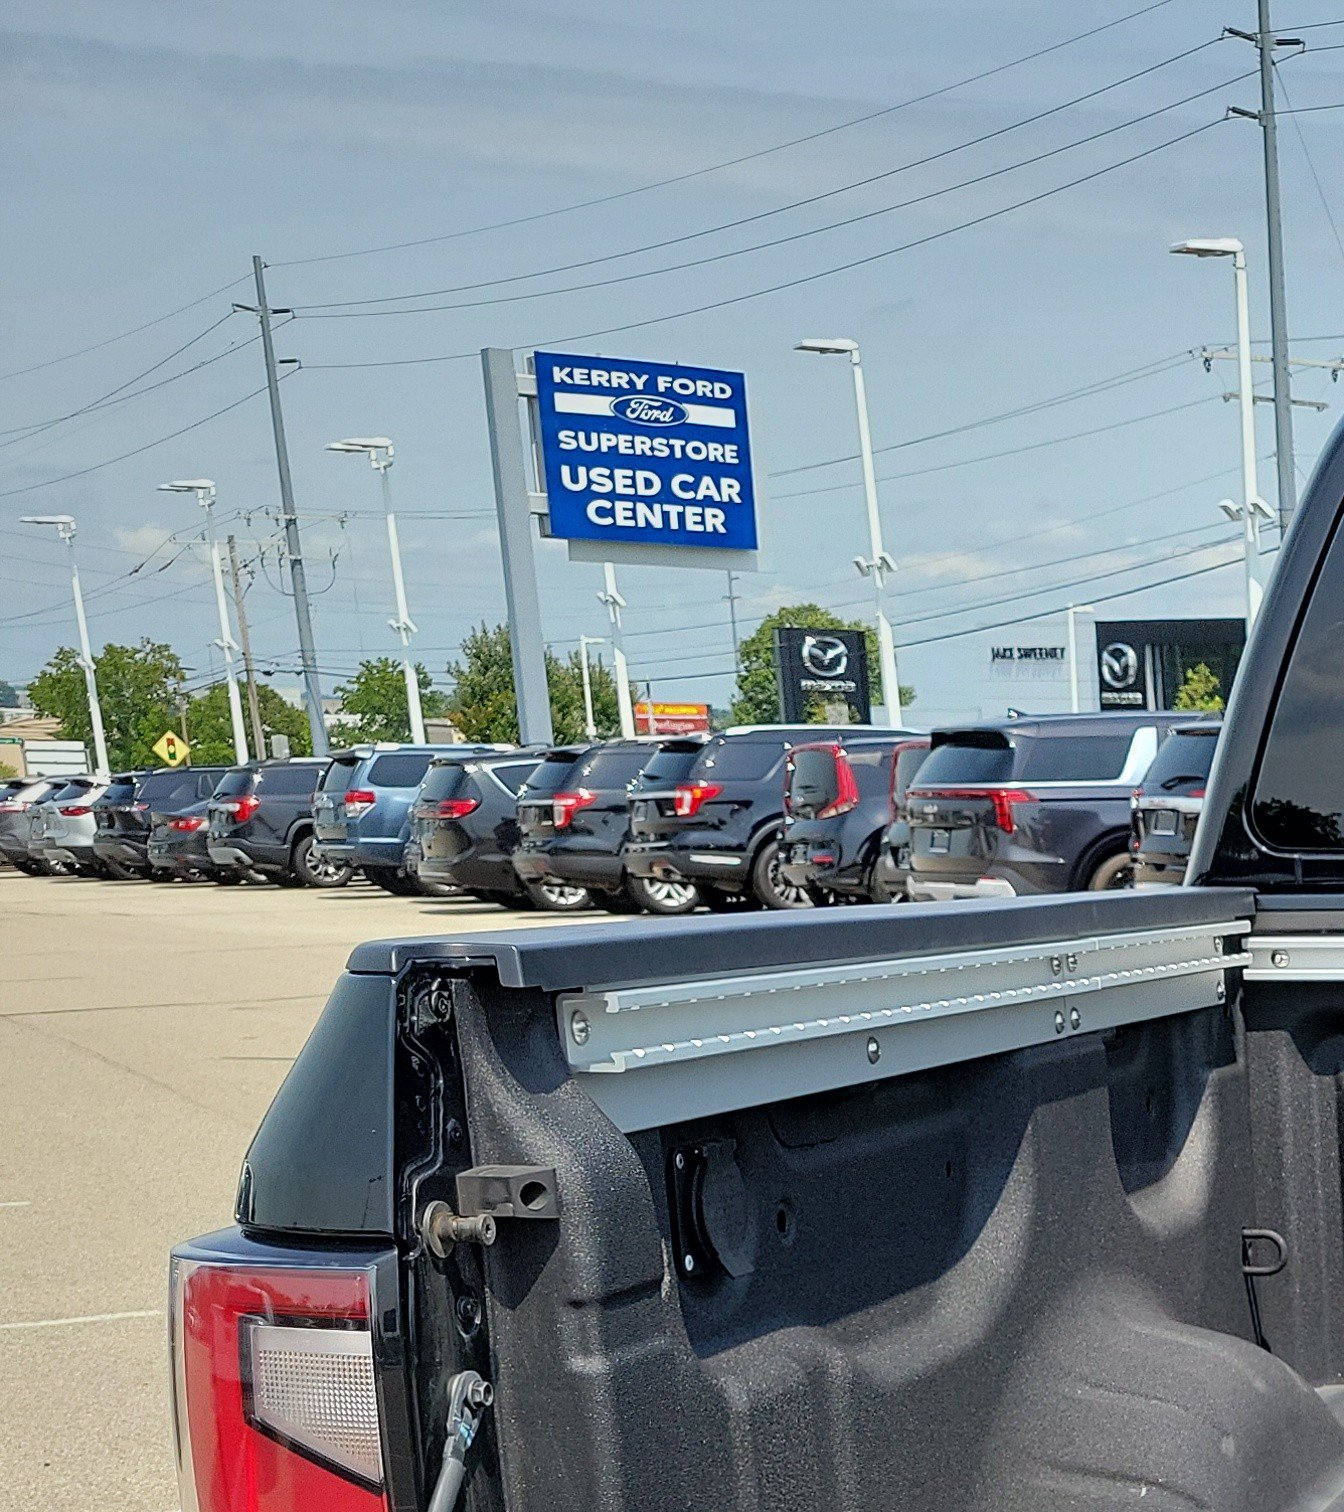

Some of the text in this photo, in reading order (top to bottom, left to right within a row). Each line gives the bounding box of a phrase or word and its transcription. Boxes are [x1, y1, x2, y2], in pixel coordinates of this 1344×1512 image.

[552, 366, 733, 399] KERRY FORD
[625, 399, 675, 422] Ford
[557, 430, 740, 464] SUPERSTORE
[560, 465, 742, 503] USED CAR
[586, 499, 728, 534] CENTER
